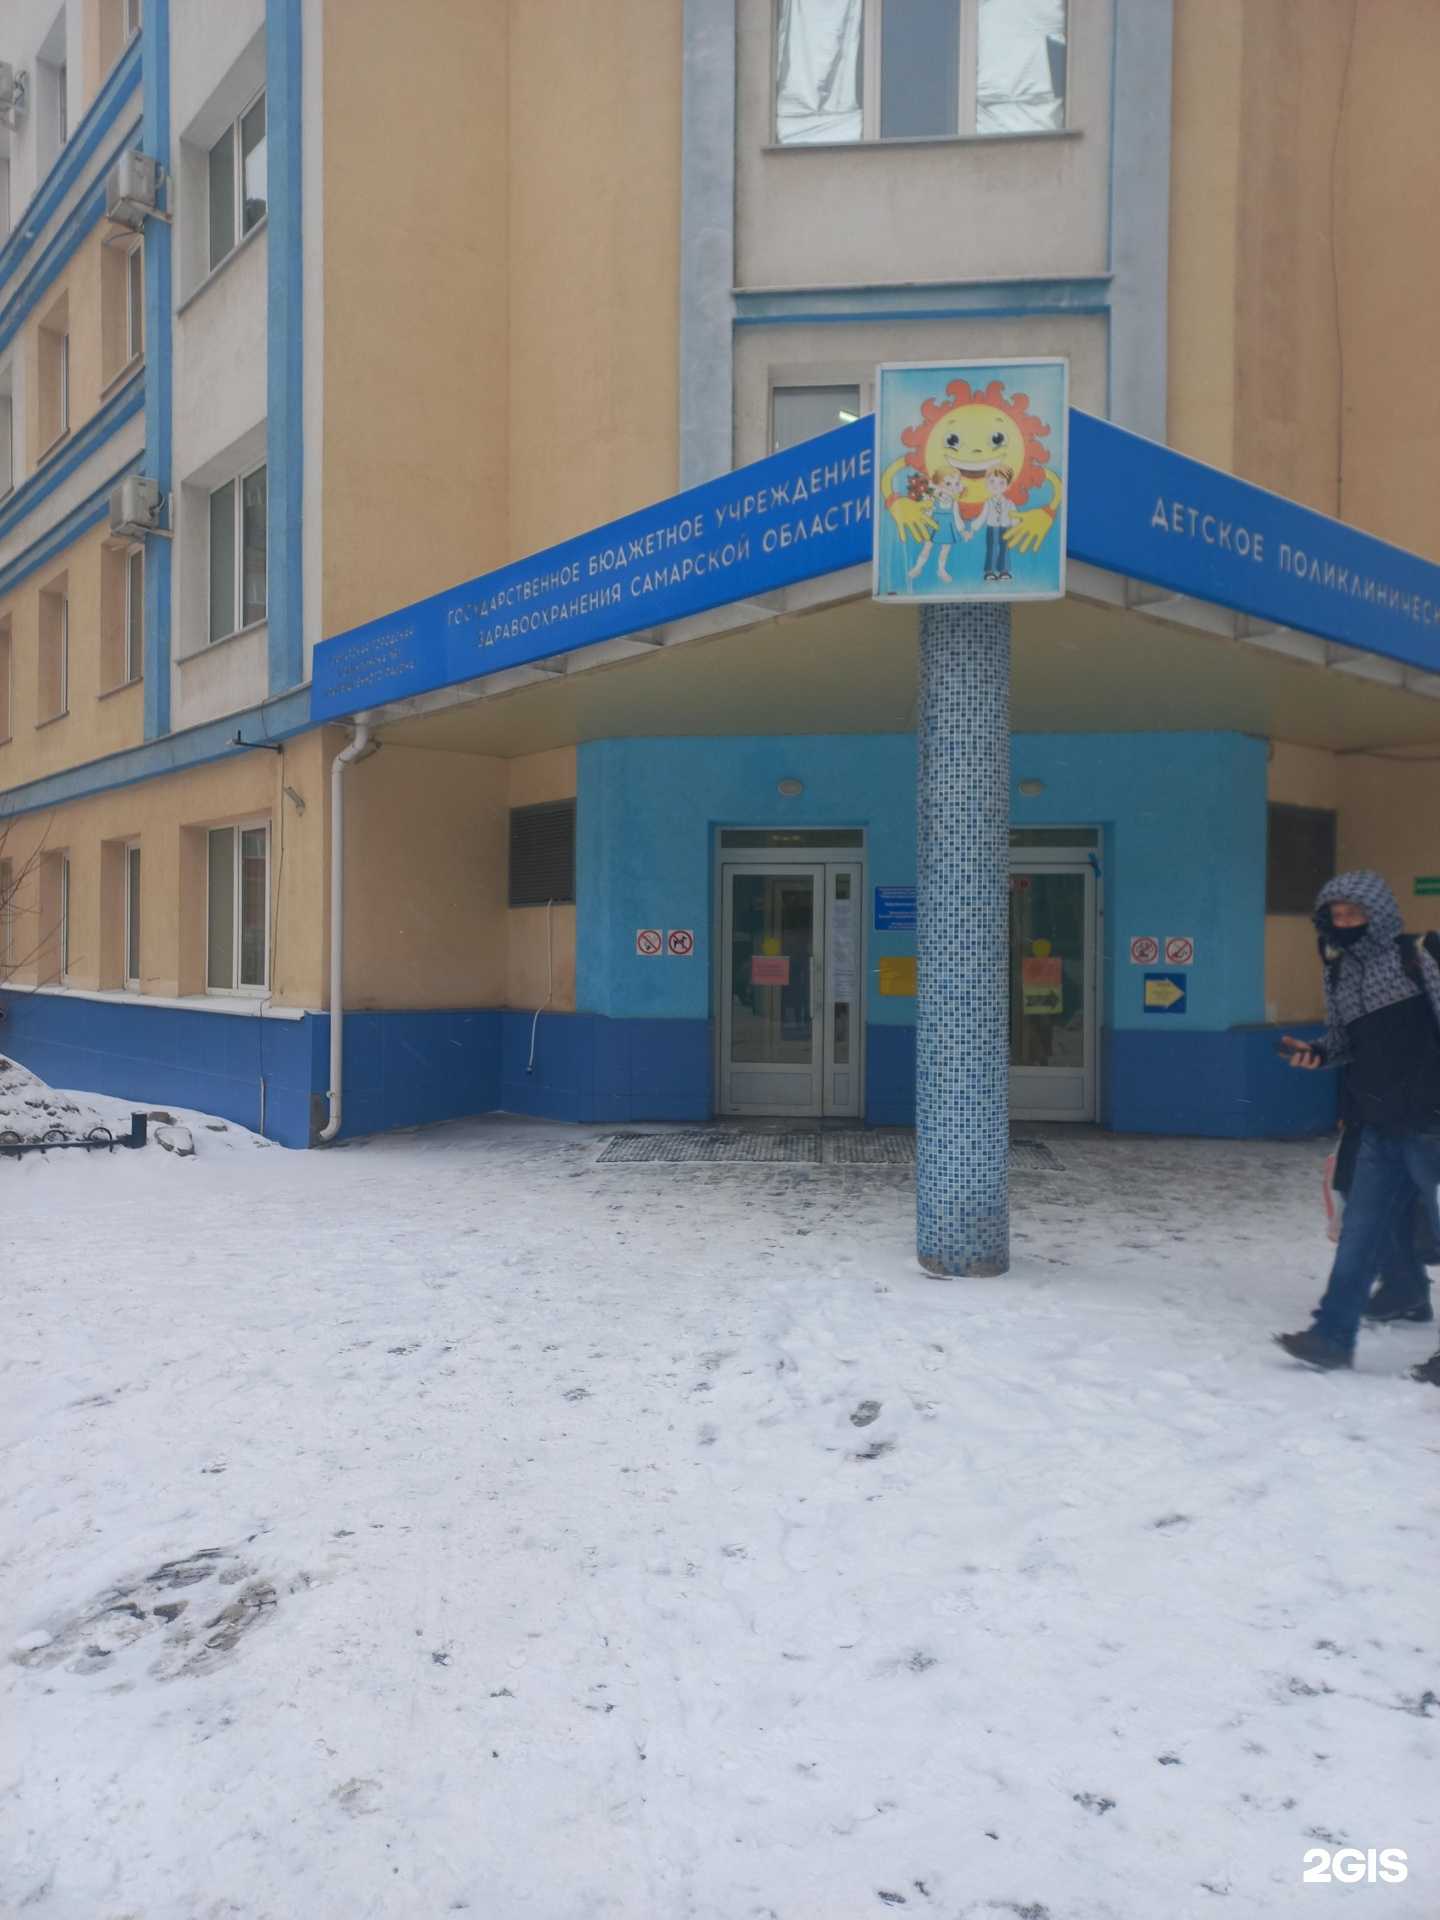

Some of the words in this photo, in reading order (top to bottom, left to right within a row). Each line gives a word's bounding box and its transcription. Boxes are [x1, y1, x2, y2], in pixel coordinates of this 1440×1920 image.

[447, 561, 581, 625] ГОСУДАРСТВЕННОЕ
[588, 514, 705, 577] БЮДЖЕТНОЕ
[715, 448, 873, 528] УЧРЕЖДЕНИЕ
[478, 582, 622, 648] ЗДРАВООХРАНЕНИЯ
[630, 533, 750, 597] САМАРСКОЙ
[762, 496, 872, 553] ОБЛАСТИ
[1151, 496, 1265, 563] ДЕТСКОЕ
